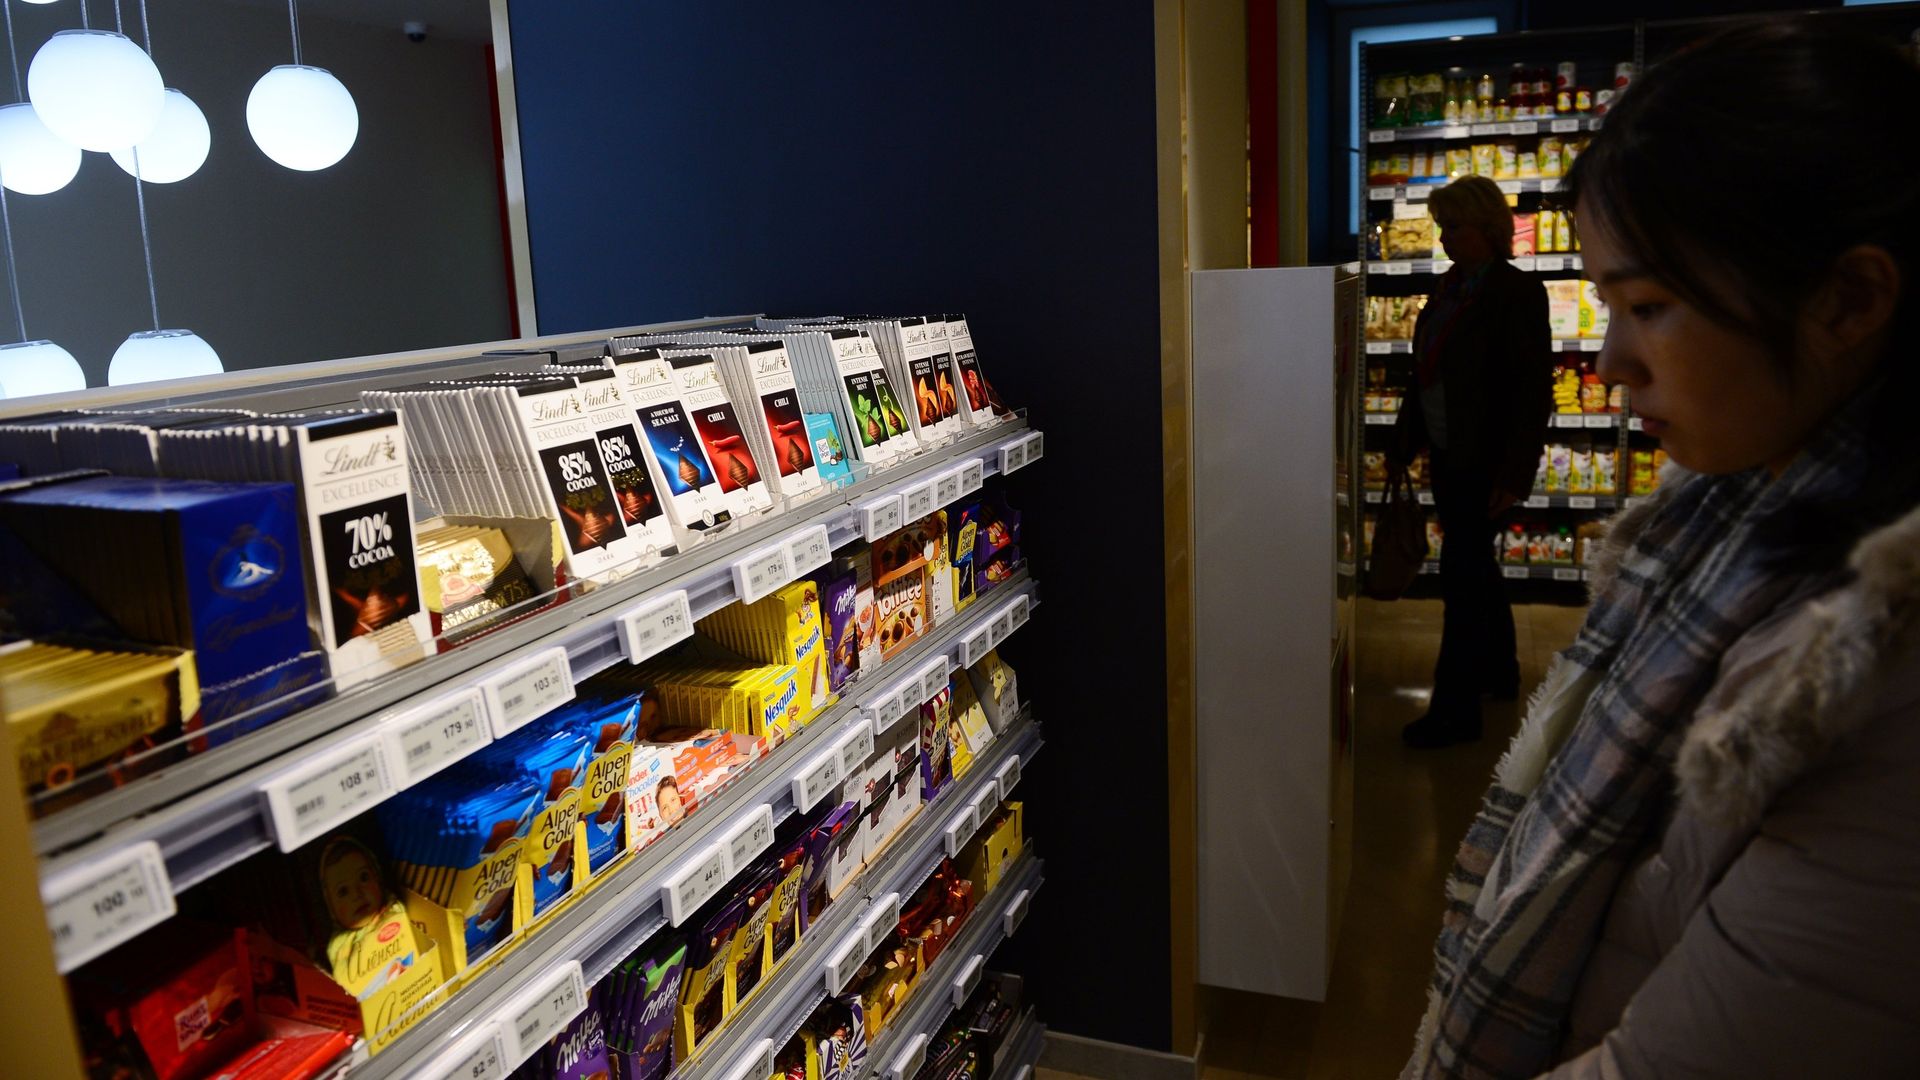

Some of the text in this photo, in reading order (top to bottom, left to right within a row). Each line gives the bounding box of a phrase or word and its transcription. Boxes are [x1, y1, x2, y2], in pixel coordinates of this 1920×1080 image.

[758, 355, 780, 374] Lindt
[627, 367, 656, 387] Lindt
[683, 371, 709, 389] Lindt
[851, 376, 868, 385] INTENSE
[857, 383, 867, 391] MINT
[532, 398, 570, 422] Lindt
[654, 408, 668, 417] TOUCH
[774, 397, 790, 408] CHILI
[591, 408, 627, 425] CELLENCE
[652, 414, 680, 428] SEA SALT
[707, 412, 726, 424] CHILI
[320, 441, 381, 476] Lindt
[602, 435, 632, 464] 85%
[558, 451, 592, 482] 85%
[609, 459, 636, 474] COCOA
[322, 472, 400, 504] EXCELLENCE
[566, 476, 598, 493] COCOA
[344, 511, 393, 554] 70%
[349, 545, 395, 569] COCOA
[809, 544, 818, 554] 179
[768, 564, 778, 575] 179
[662, 615, 675, 629] 179
[795, 625, 821, 662] Nesquik
[534, 677, 550, 693] 103
[765, 679, 798, 727] Nesquik
[444, 721, 462, 740] 179
[590, 751, 631, 784] Alpen
[338, 772, 362, 792] 108
[592, 772, 626, 800] Gold
[627, 774, 660, 797] hocolate
[540, 797, 581, 833] Alpen
[543, 820, 576, 851] Gold
[472, 846, 524, 887] Alpen
[474, 864, 516, 902] Gold
[553, 995, 565, 1010] 71
[640, 972, 682, 1026] Milka
[556, 1010, 601, 1074] Milka
[472, 1060, 486, 1078] 82
